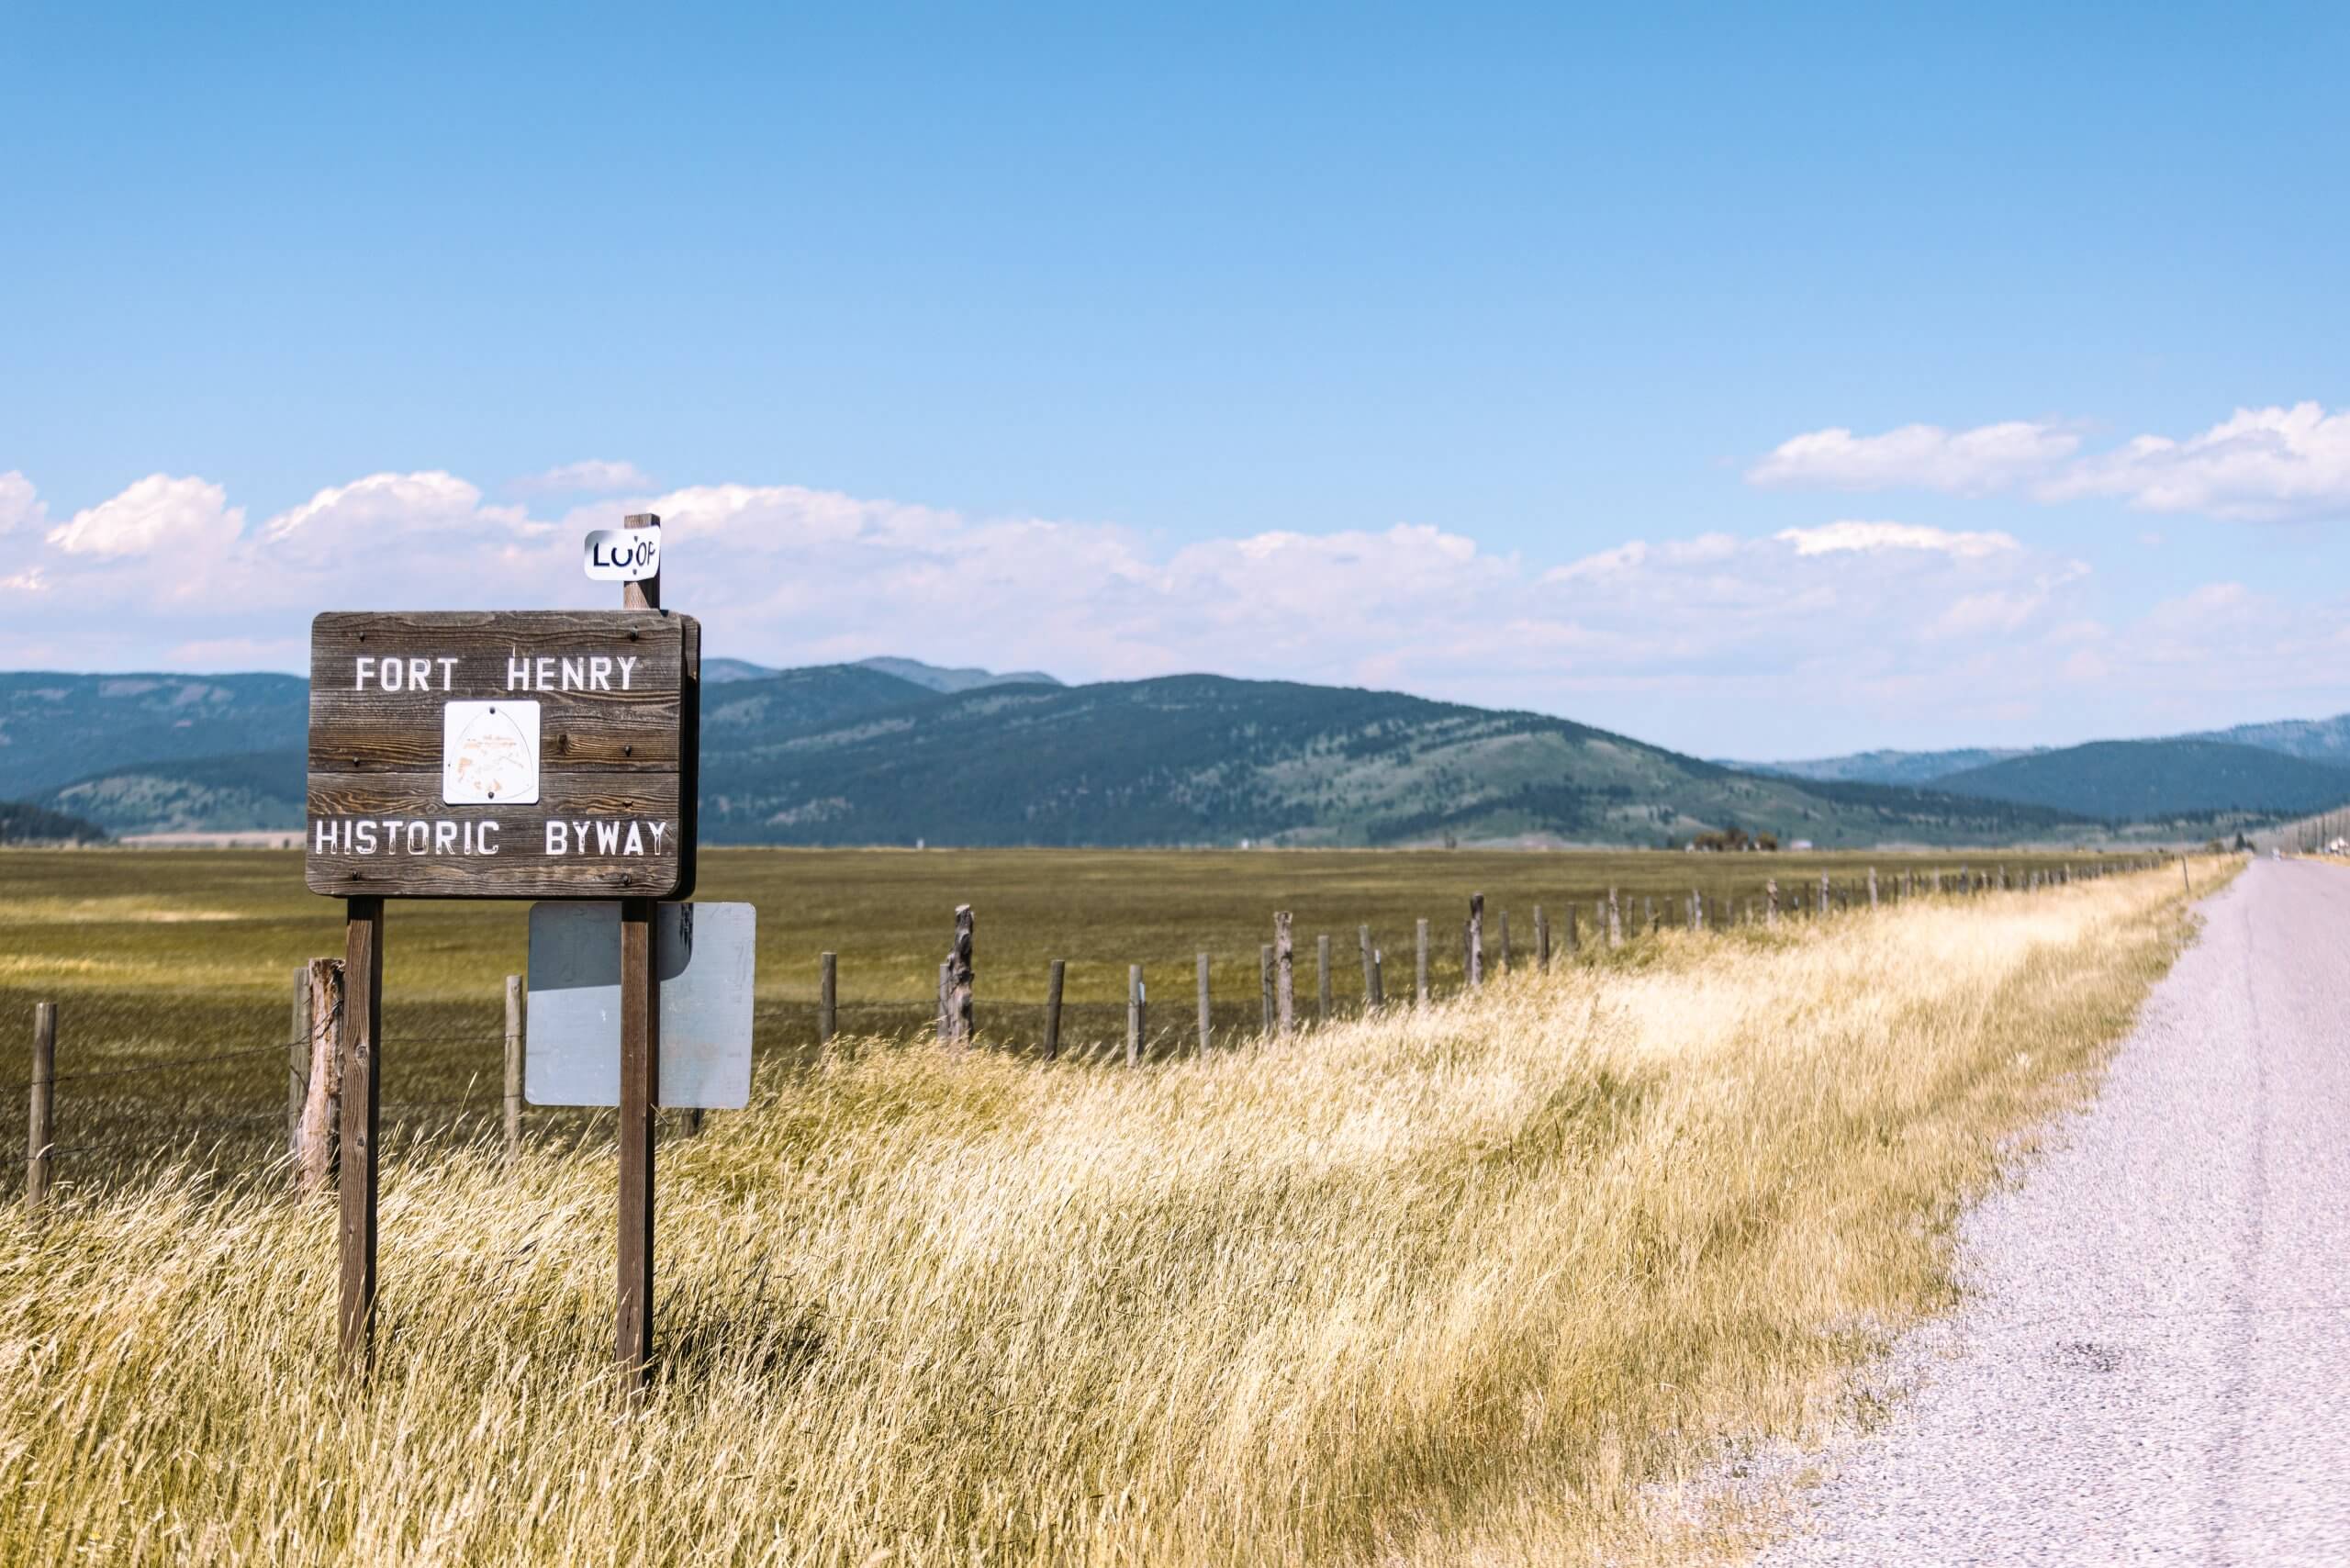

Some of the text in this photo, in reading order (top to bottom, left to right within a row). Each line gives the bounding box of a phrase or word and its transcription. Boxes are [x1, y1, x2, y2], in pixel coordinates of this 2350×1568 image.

[593, 541, 655, 566] LOOP
[355, 655, 637, 691] FORT HENRY
[315, 820, 667, 857] HISTORIC BYWAY
